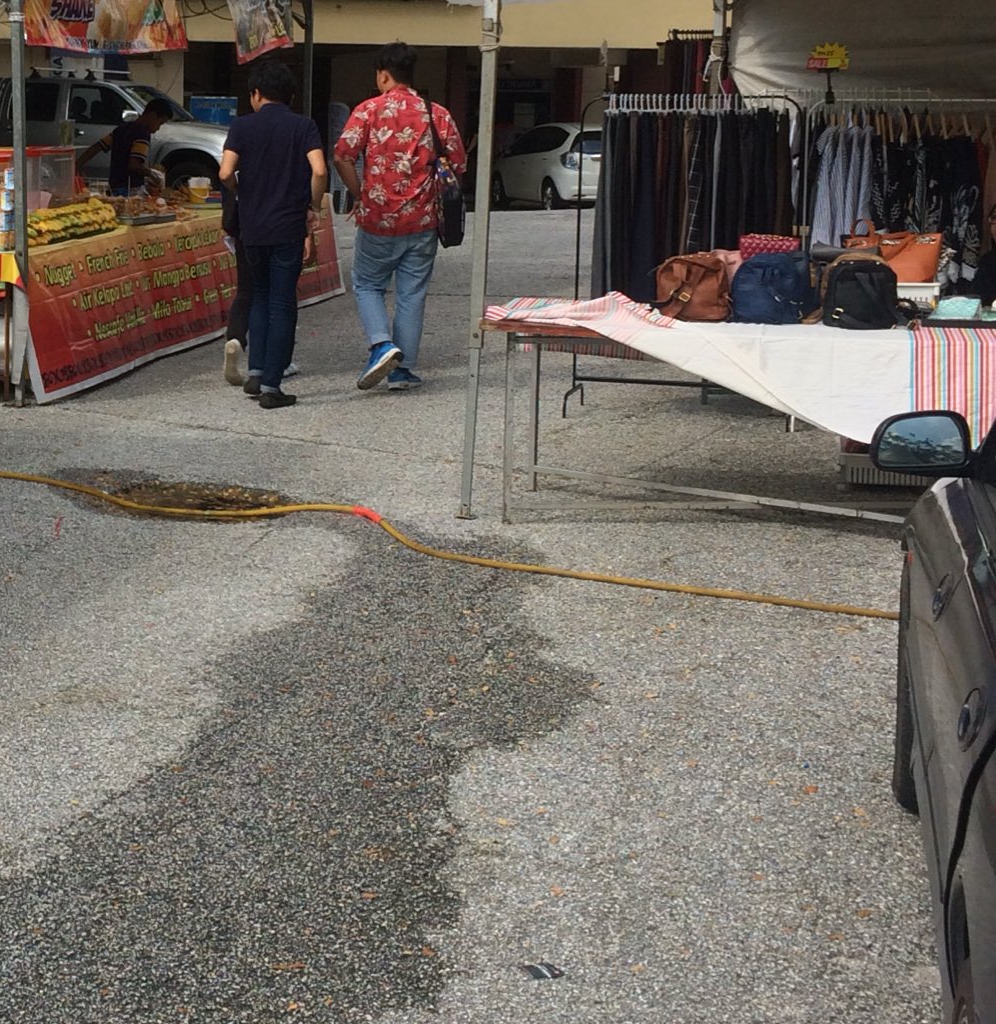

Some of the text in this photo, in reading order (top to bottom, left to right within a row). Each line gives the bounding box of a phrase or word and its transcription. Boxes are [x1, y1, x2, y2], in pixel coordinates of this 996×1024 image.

[44, 263, 77, 286] Nugget
[86, 252, 113, 274] French
[79, 291, 92, 310] Air
[92, 285, 121, 307] Kelapa
